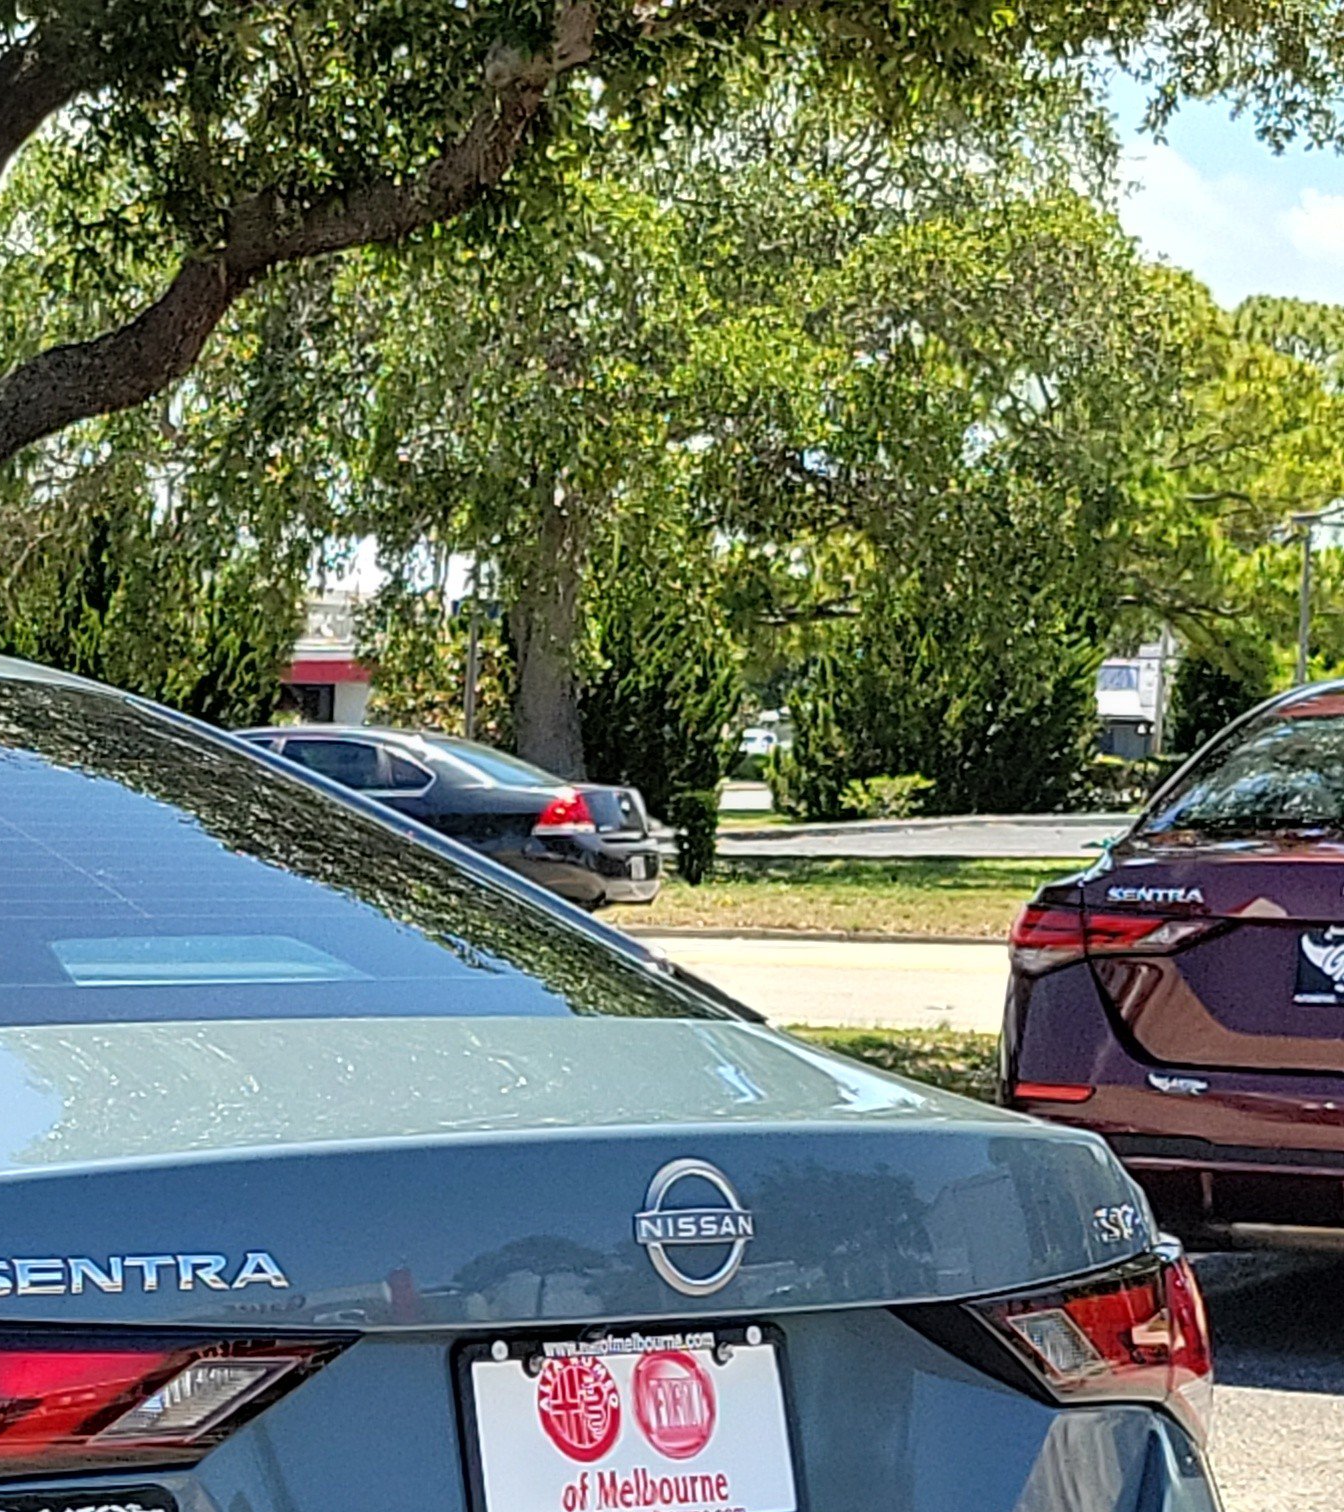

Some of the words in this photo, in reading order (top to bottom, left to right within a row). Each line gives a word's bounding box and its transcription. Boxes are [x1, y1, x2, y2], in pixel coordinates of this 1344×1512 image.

[1107, 885, 1204, 903] SENTRA
[640, 1215, 753, 1238] NISSAN
[562, 1473, 588, 1512] of
[598, 1468, 729, 1510] Melbourne
